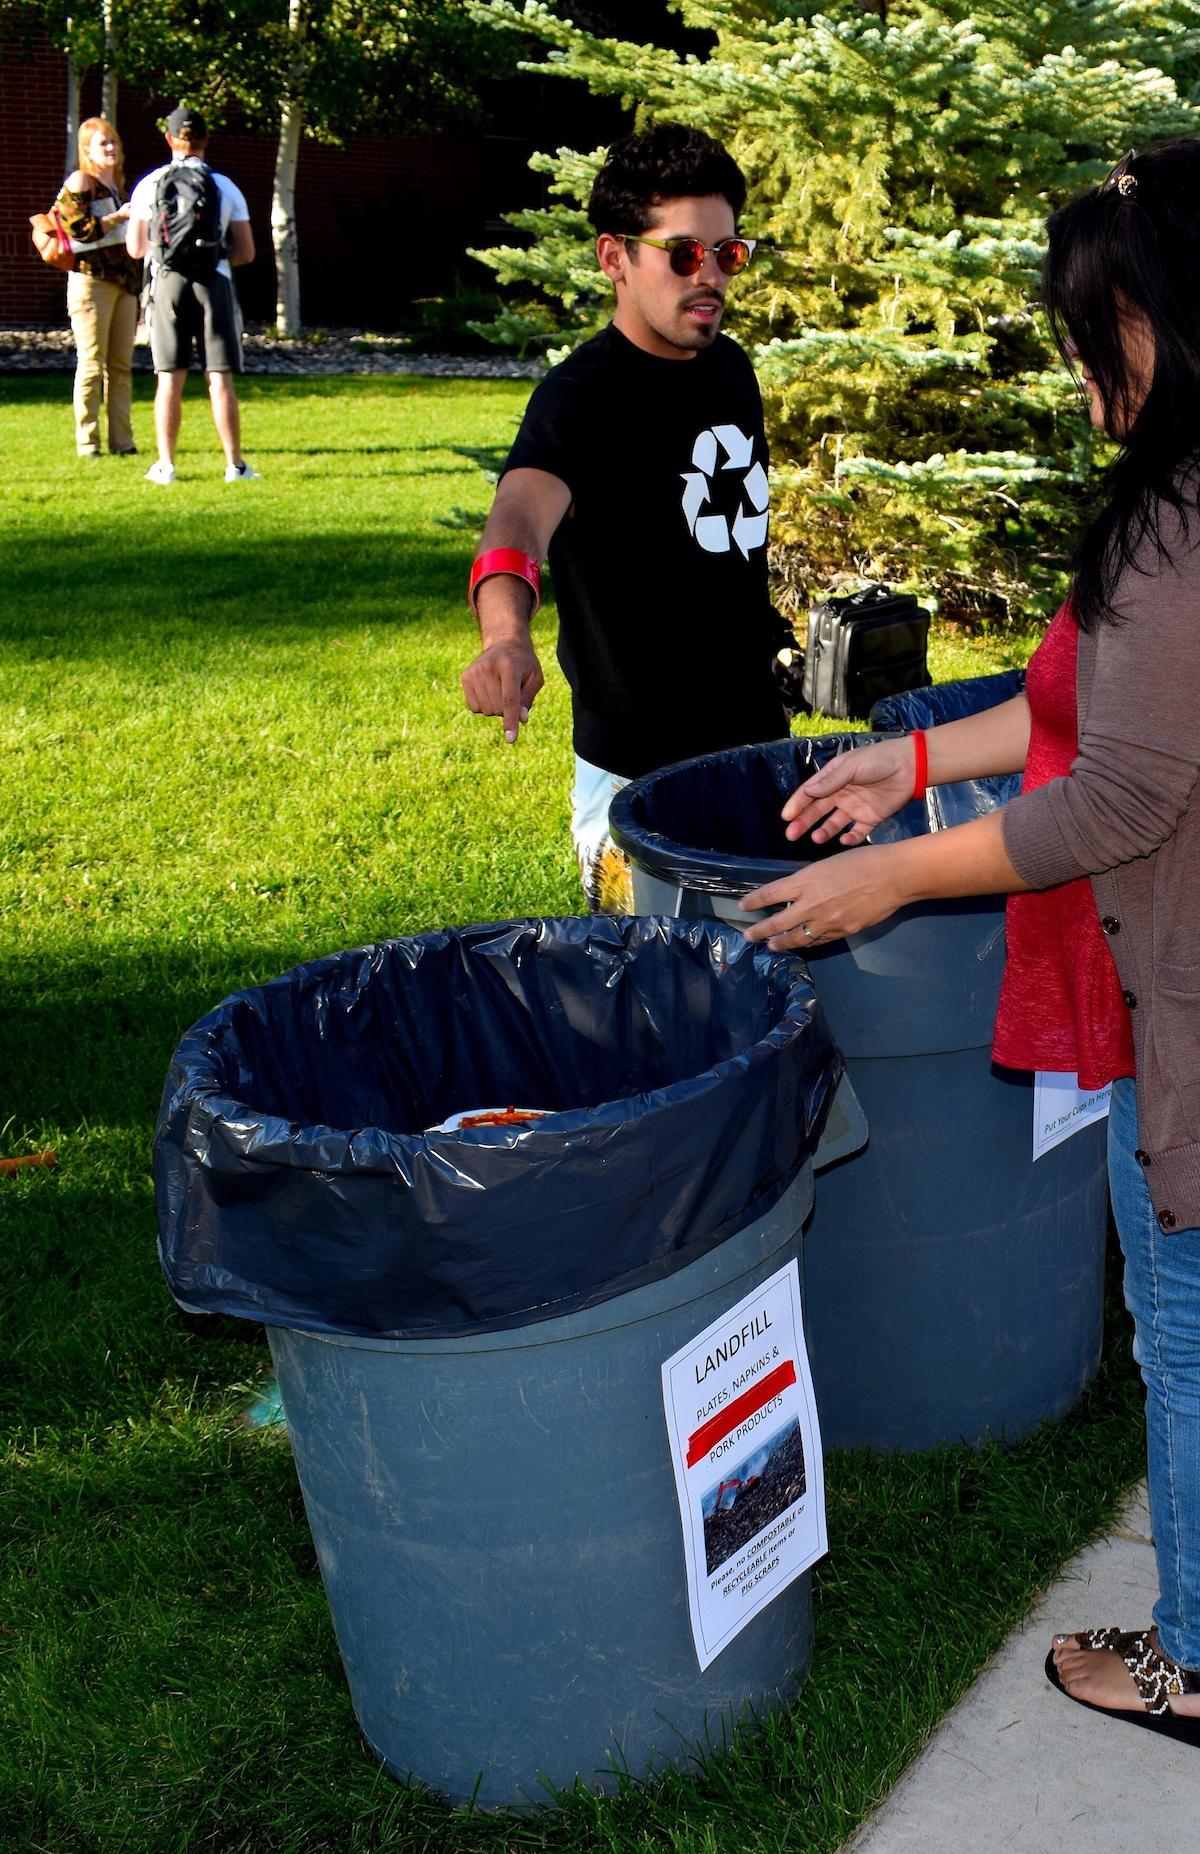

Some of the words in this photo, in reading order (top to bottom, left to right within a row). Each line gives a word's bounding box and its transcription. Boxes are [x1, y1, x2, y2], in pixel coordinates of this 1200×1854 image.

[1044, 1121, 1056, 1134] Put
[1058, 1112, 1071, 1126] Your
[1072, 1102, 1087, 1116] Cups
[695, 1310, 773, 1385] LANDFILL
[696, 1388, 731, 1422] PLATES,
[732, 1352, 771, 1392] NAPKINS
[772, 1345, 780, 1359] &
[709, 1438, 737, 1464] PORK
[737, 1393, 783, 1442] PRODUCTS
[710, 1566, 736, 1591] Please,
[736, 1556, 746, 1568] no
[746, 1511, 797, 1561] COMPOSTABLE
[797, 1504, 805, 1515] or
[722, 1551, 768, 1598] RECYCLEABLE
[768, 1533, 787, 1555] items
[788, 1527, 797, 1538] or
[740, 1578, 755, 1597] PIG
[753, 1555, 780, 1582] SCRAPS
